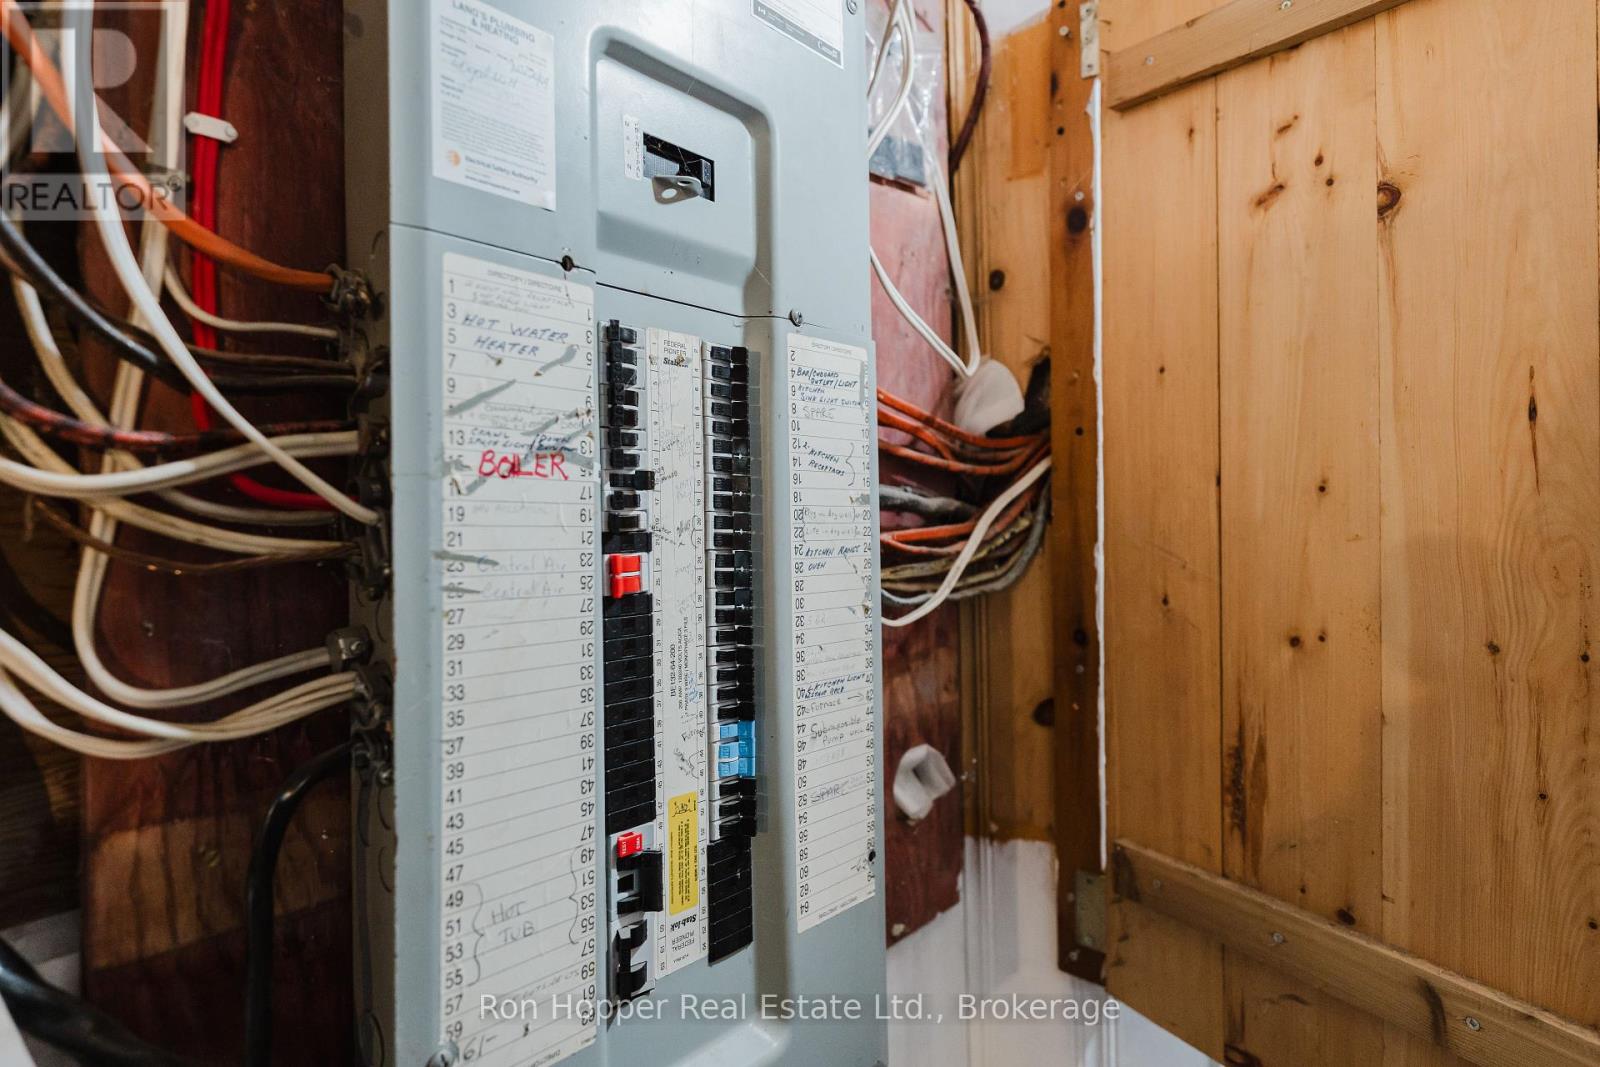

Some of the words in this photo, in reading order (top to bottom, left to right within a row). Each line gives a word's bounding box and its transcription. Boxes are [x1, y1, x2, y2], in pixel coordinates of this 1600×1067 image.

[480, 21, 519, 46] HEATING
[449, 280, 454, 292] 1
[447, 303, 456, 318] 3
[448, 328, 456, 343] 5
[462, 314, 499, 330] HOT
[511, 322, 569, 344] WATER
[586, 330, 592, 344] 3
[474, 336, 540, 356] HEATER
[448, 353, 456, 368] 7
[586, 352, 592, 366] 5
[447, 378, 455, 393] 9
[586, 376, 592, 388] 7
[449, 430, 464, 445] 13
[580, 441, 592, 454] 13
[478, 449, 569, 481] BOILER
[580, 486, 592, 500] 17
[449, 506, 464, 522] 19
[580, 508, 592, 522] 19
[447, 532, 462, 547] 21
[581, 531, 593, 544] 21
[580, 552, 593, 567] 23
[580, 576, 593, 591] 25
[580, 598, 593, 612] 27
[447, 608, 464, 624] 27
[580, 620, 593, 635] 29
[447, 634, 464, 651] 29
[582, 643, 593, 657] 31
[447, 660, 463, 676] 31
[580, 665, 594, 680] 33
[447, 684, 464, 701] 33
[580, 687, 594, 703] 35
[447, 710, 464, 728] 35
[580, 711, 594, 727] 37
[446, 737, 464, 755] 37
[580, 734, 594, 749] 39
[446, 762, 464, 780] 39
[582, 756, 594, 771] 41
[580, 779, 594, 794] 43
[445, 788, 462, 803] 41
[581, 801, 594, 817] 45
[445, 812, 464, 830] 43
[581, 824, 594, 841] 47
[445, 838, 464, 855] 45
[581, 848, 594, 863] 49
[445, 864, 464, 882] 47
[582, 870, 594, 887] 51
[446, 890, 464, 907] 49
[581, 893, 594, 910] 53
[492, 901, 526, 925] HOT
[446, 918, 461, 936] 51
[502, 921, 535, 944] TUB
[581, 915, 594, 934] 55
[445, 943, 463, 962] 53
[581, 938, 595, 957] 57
[581, 961, 595, 980] 59
[445, 969, 463, 989] 55
[445, 994, 463, 1016] 57
